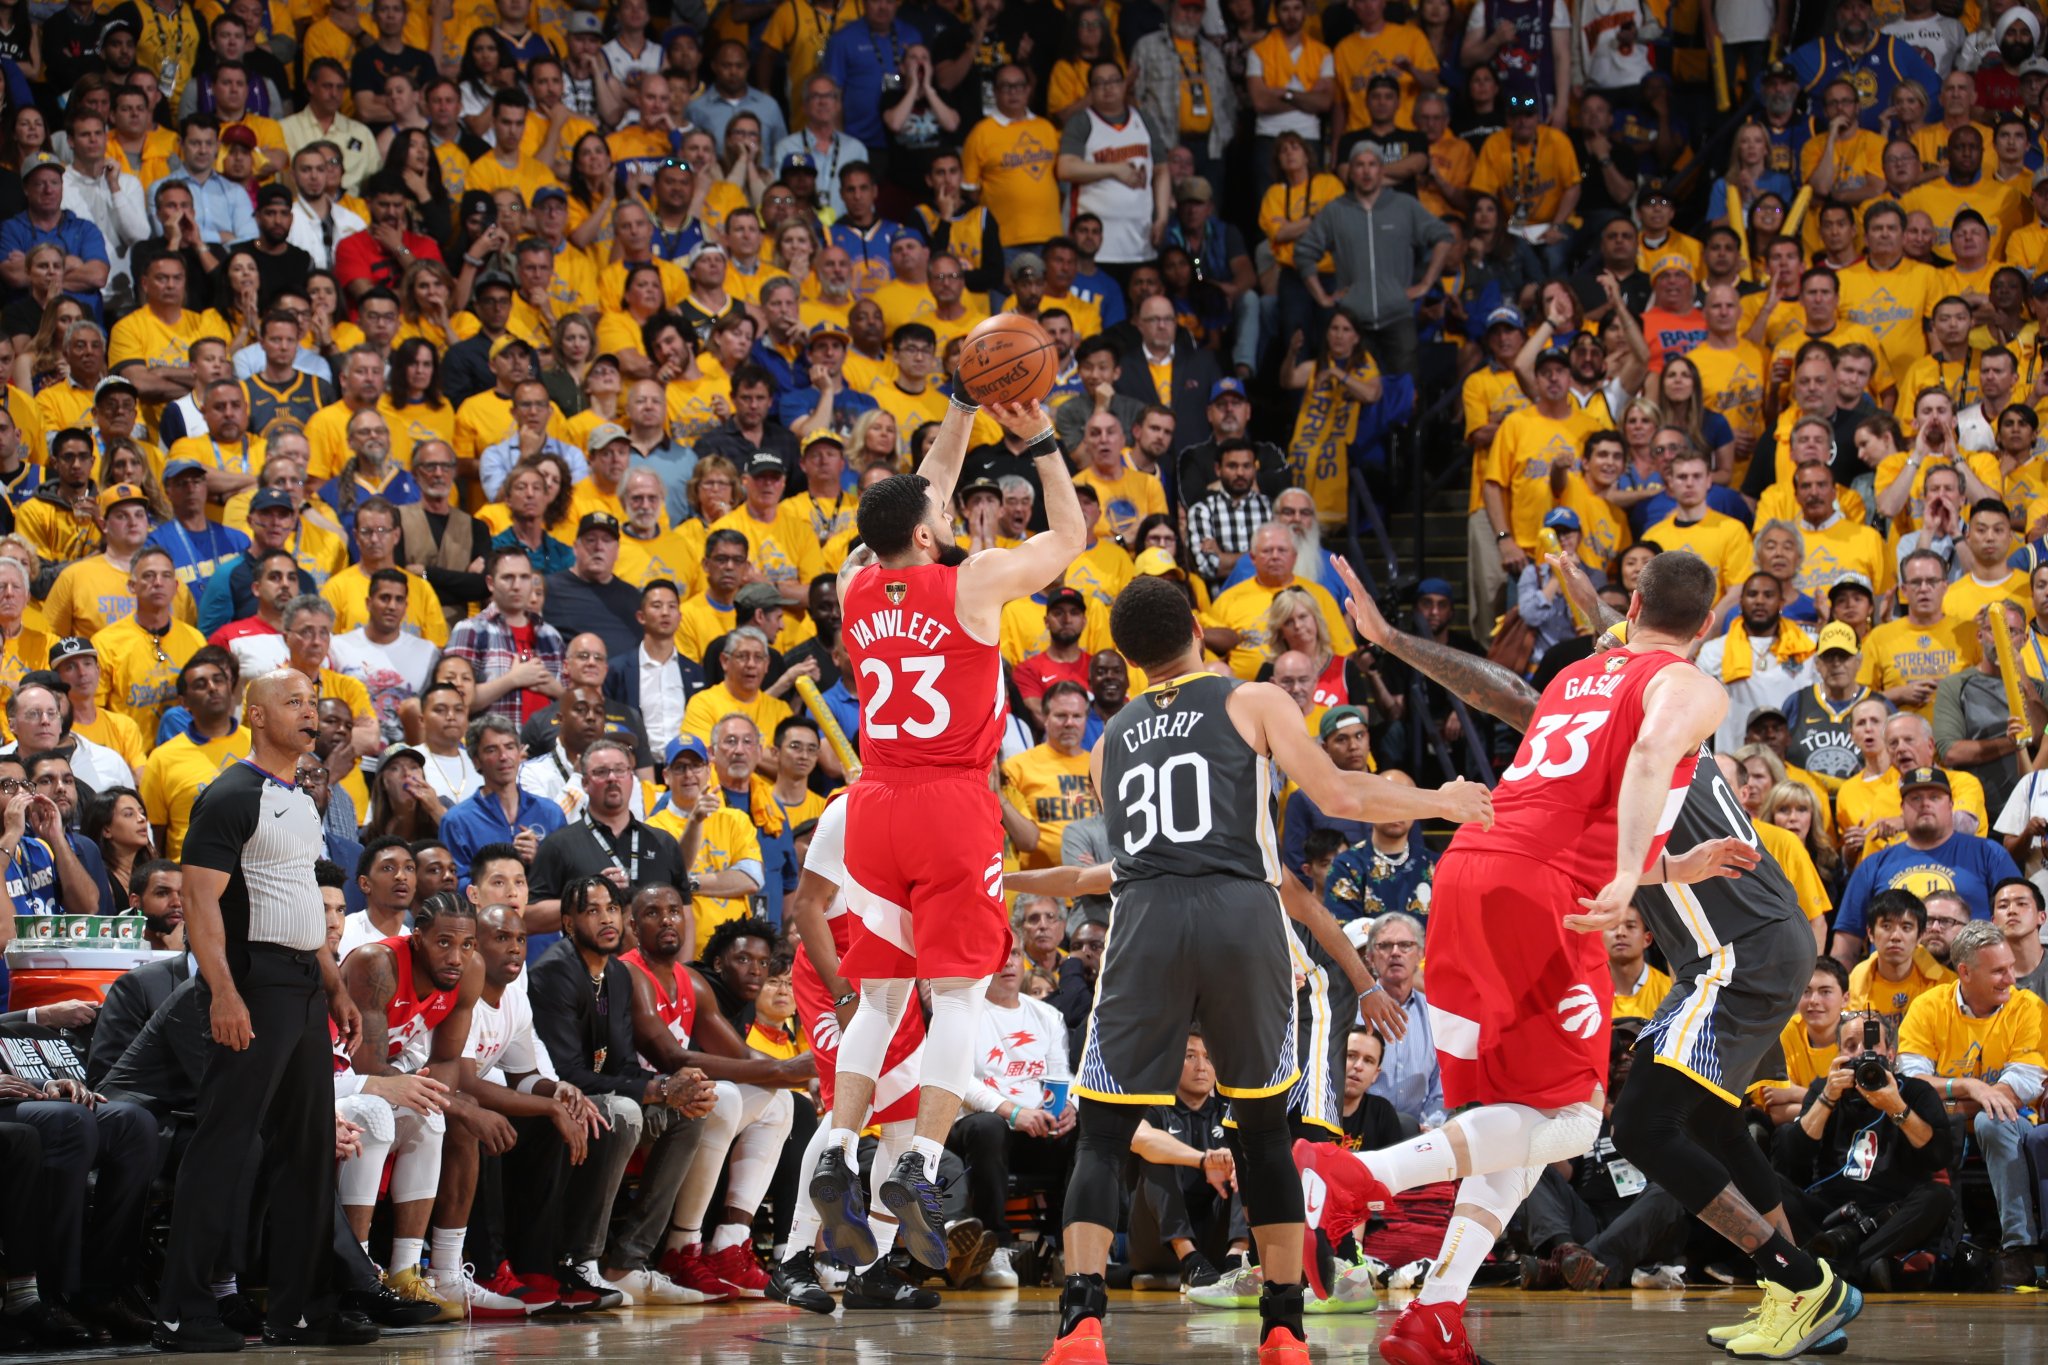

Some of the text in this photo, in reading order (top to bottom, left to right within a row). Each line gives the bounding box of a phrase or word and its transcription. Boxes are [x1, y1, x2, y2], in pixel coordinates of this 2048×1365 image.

[98, 596, 138, 613] STRE
[849, 609, 952, 650] VANVLEET
[1893, 650, 1957, 669] STRENGTH
[860, 655, 950, 739] 23
[1564, 674, 1626, 701] GASOL
[1122, 711, 1193, 753] CURRY
[1502, 710, 1611, 782] 33
[1118, 752, 1213, 856] 30
[1711, 773, 1758, 850] 0
[37, 922, 52, 940] G
[68, 922, 88, 940] G
[116, 922, 133, 940] G
[54, 1039, 80, 1066] 2019
